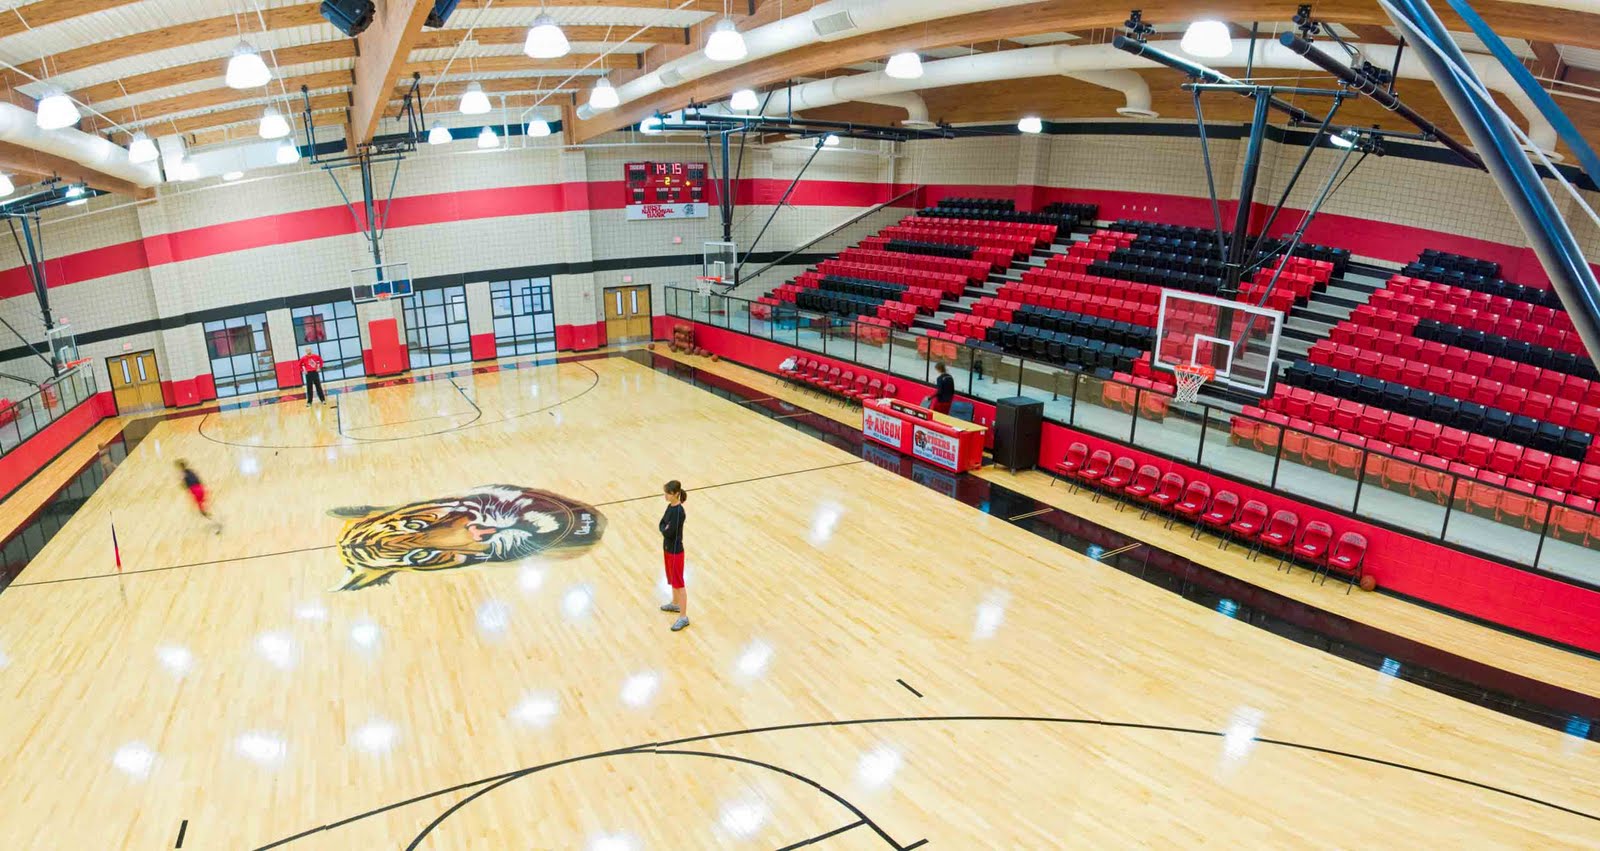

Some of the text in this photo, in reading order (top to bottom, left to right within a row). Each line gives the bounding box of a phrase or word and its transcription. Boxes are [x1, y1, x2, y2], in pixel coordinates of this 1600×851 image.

[664, 176, 671, 185] 2
[874, 417, 901, 441] ANSON
[927, 434, 951, 450] TIGERS
[931, 446, 955, 462] TIGERS
